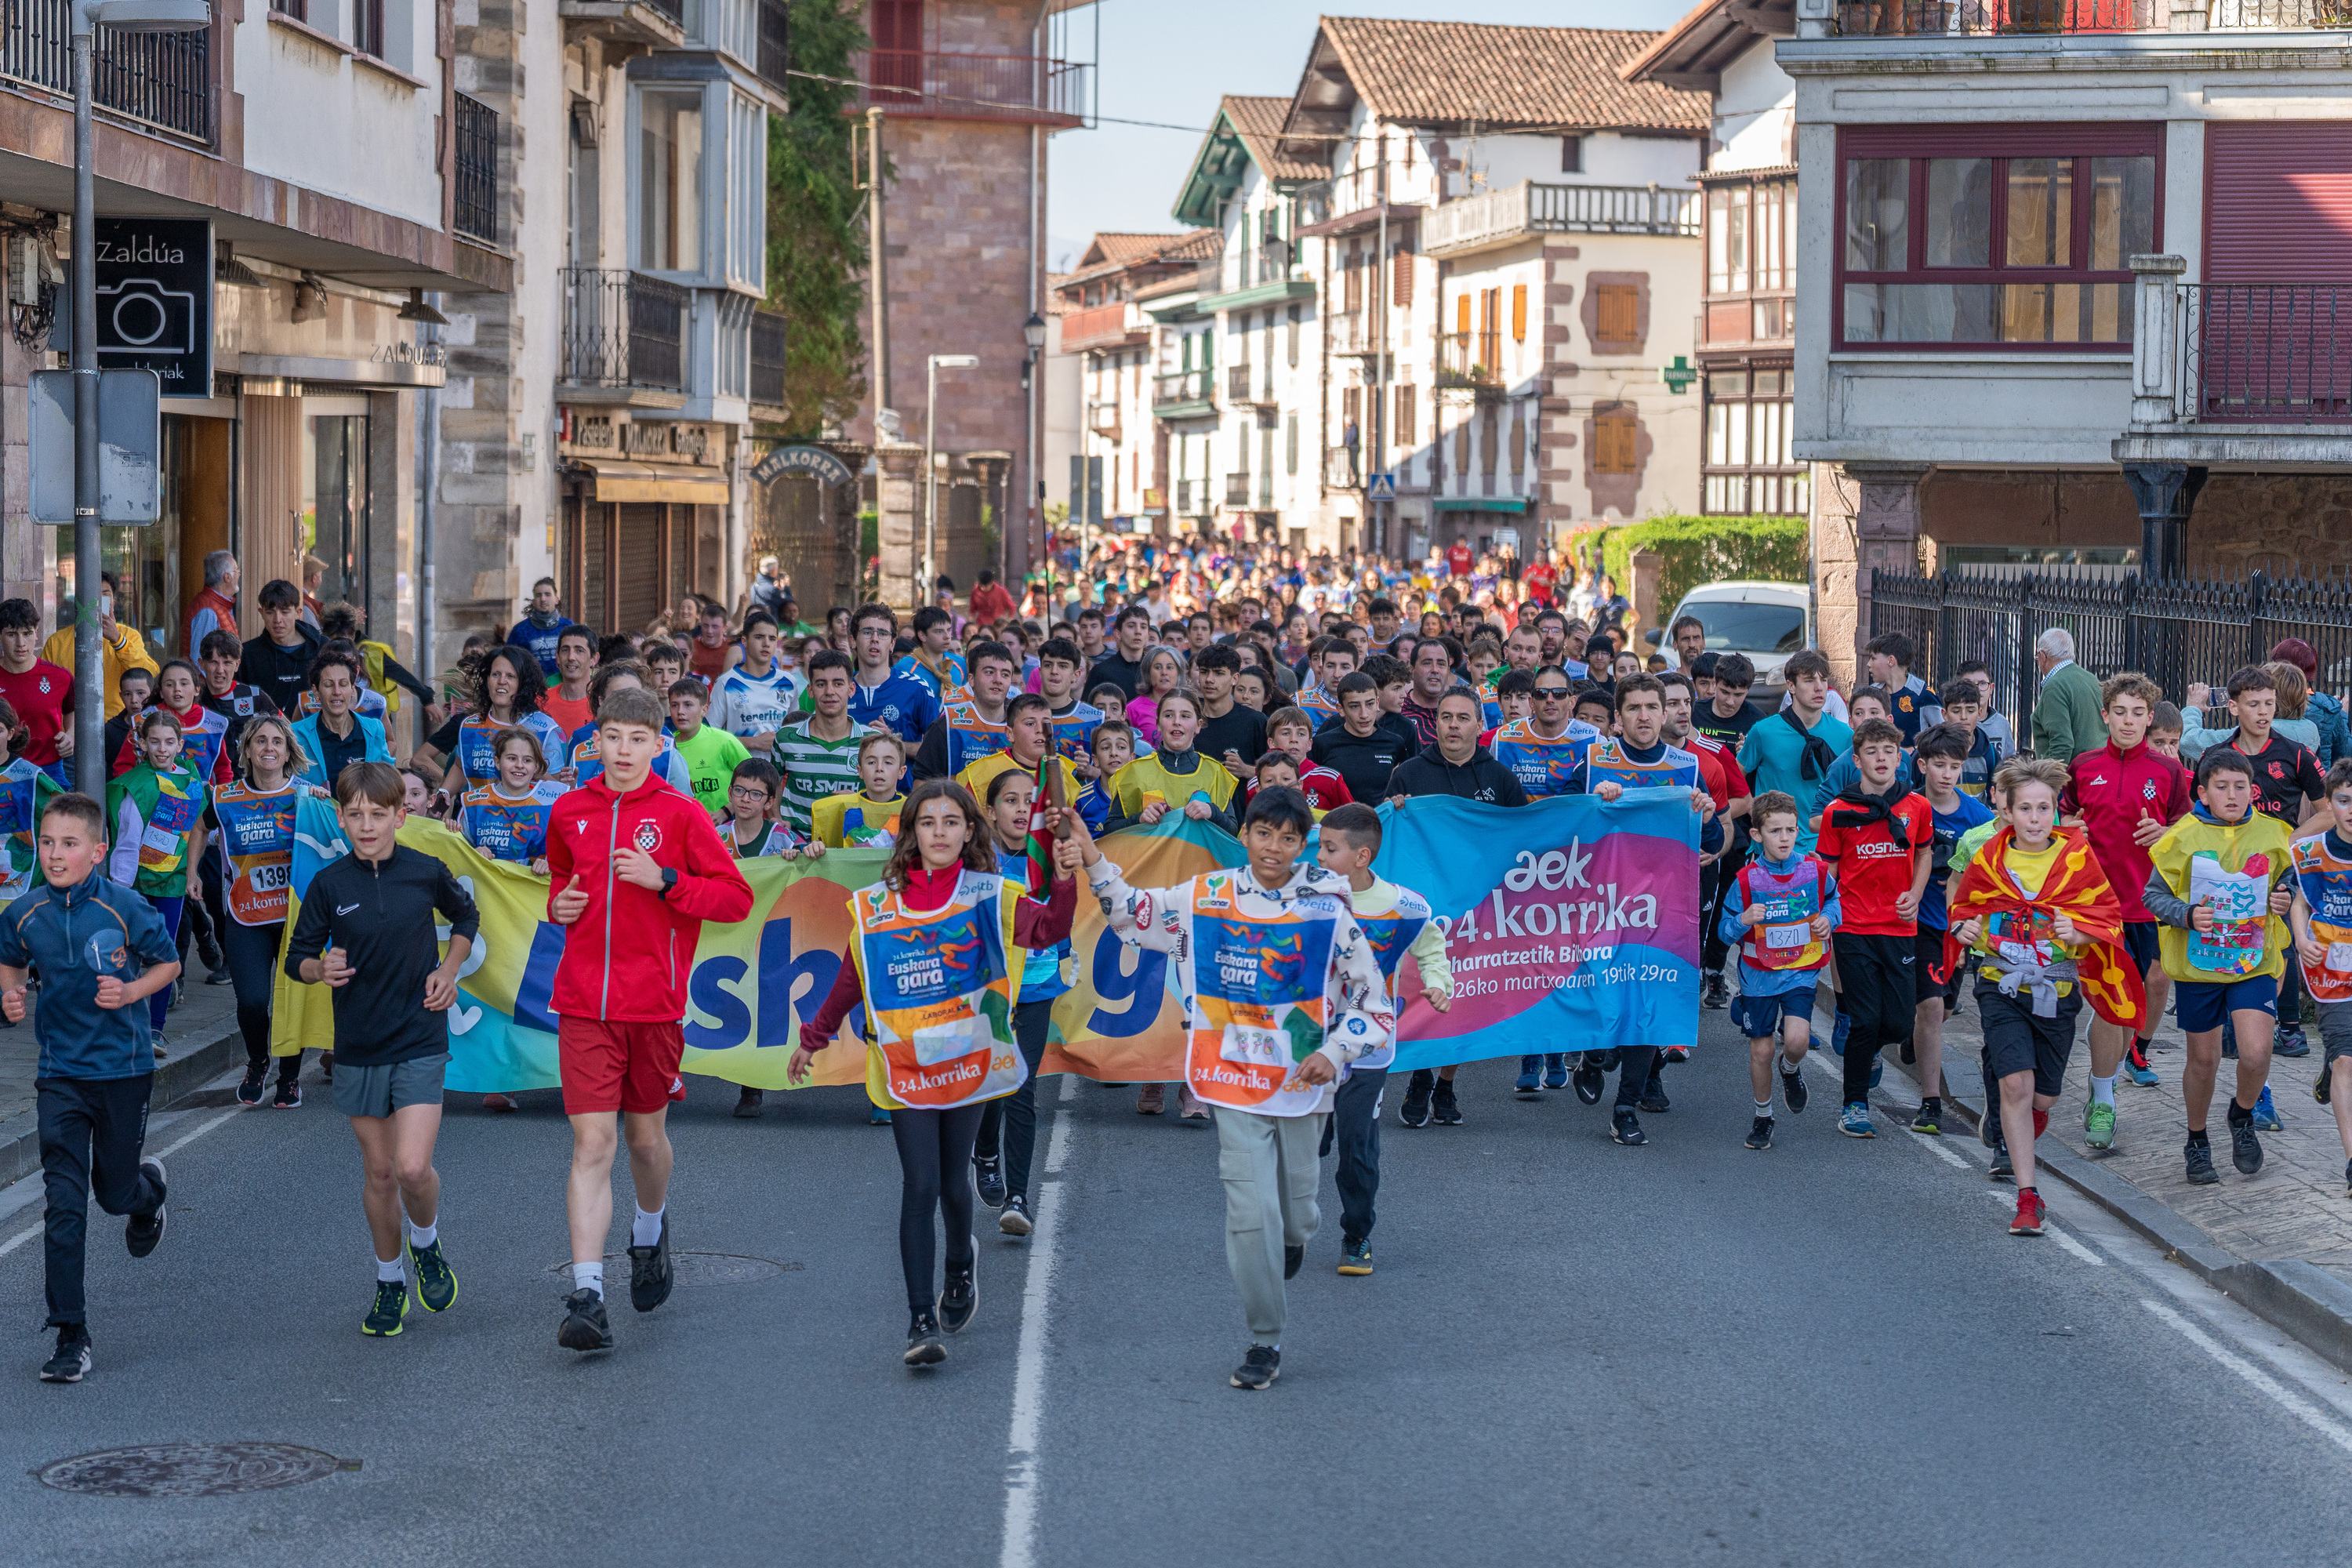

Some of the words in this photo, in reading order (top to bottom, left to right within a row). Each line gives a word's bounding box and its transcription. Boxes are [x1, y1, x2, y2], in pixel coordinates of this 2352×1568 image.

[96, 234, 184, 263] Zaldúa
[757, 451, 841, 483] MALKORRA
[211, 719, 224, 729] eitb
[532, 719, 548, 729] eitb
[1699, 727, 1719, 736] RUN
[1677, 753, 1696, 763] eitb
[16, 767, 33, 776] eitb
[1512, 764, 1547, 773] Euskara
[693, 777, 719, 794] NKA
[795, 779, 813, 793] CR
[815, 779, 860, 793] SMITH
[545, 790, 561, 800] eit
[2257, 800, 2281, 812] NIQ
[235, 821, 273, 832] Euskara
[477, 827, 510, 837] Euskara
[148, 829, 170, 847] 1370
[240, 828, 274, 846] gara
[1504, 835, 1592, 892] aek
[4, 874, 24, 889] aek
[970, 880, 993, 895] eitb
[238, 892, 290, 913] 24.korrik
[1309, 899, 1336, 913] eitb
[1409, 900, 1428, 913] eitb
[1431, 883, 1658, 947] 24.korrika
[1766, 909, 1789, 920] gara
[1769, 928, 1799, 947] 1370
[1214, 950, 1258, 969] Euskara
[1450, 945, 1555, 974] harratzetik
[1559, 945, 1613, 964] Bilbora
[2337, 946, 2352, 967] 13
[887, 957, 941, 976] Euskara
[1220, 965, 1258, 985] gara
[896, 969, 944, 995] gara
[1446, 978, 1498, 1000] 26ko
[1504, 971, 1595, 992] martxoaren
[1602, 964, 1636, 985] 19tik
[1639, 964, 1679, 983] 29ra
[898, 1062, 982, 1094] 24.korrika
[991, 1051, 1019, 1072] aek
[1194, 1065, 1272, 1091] 24.korrika
